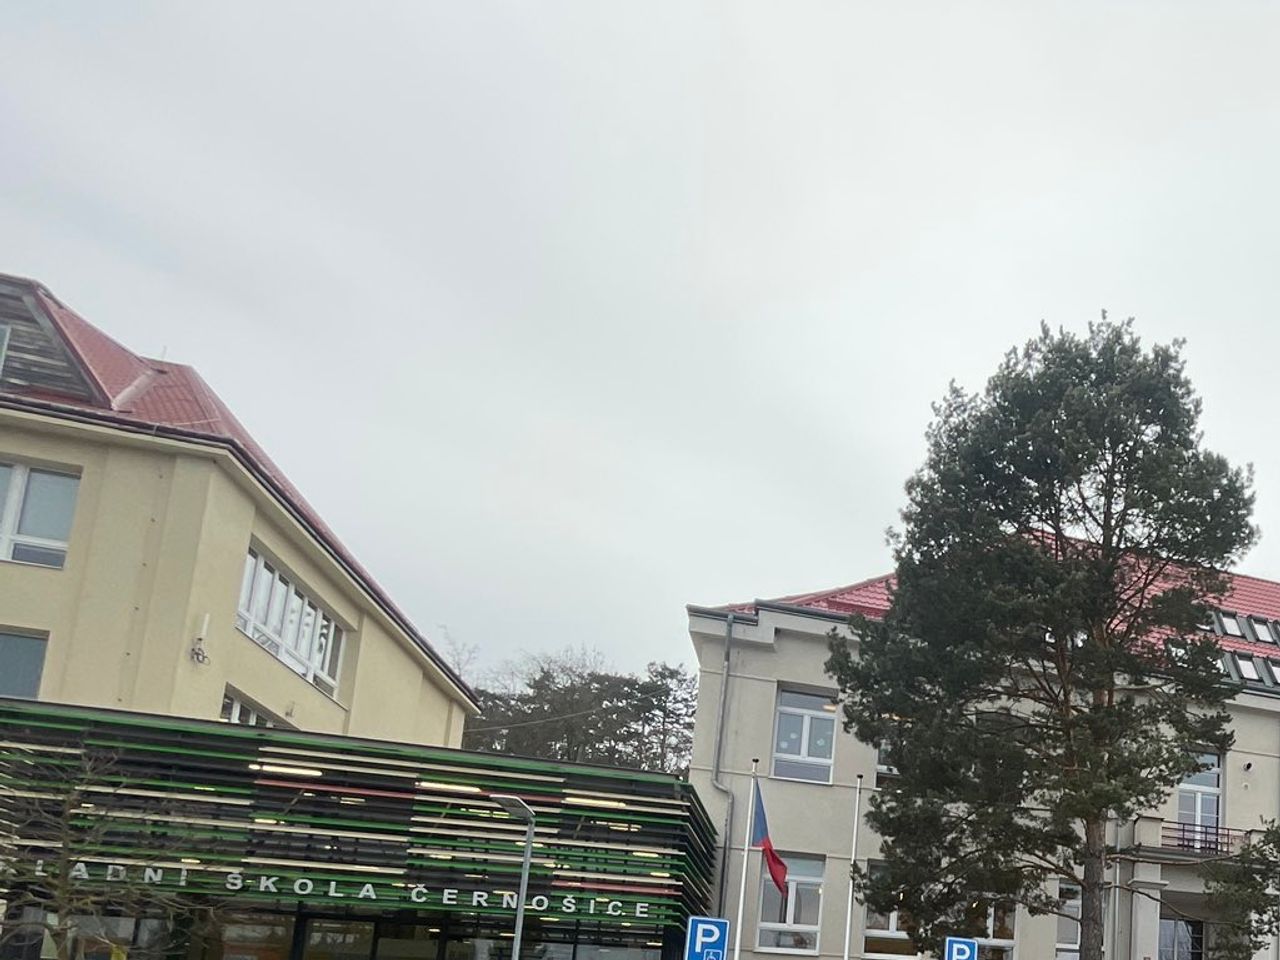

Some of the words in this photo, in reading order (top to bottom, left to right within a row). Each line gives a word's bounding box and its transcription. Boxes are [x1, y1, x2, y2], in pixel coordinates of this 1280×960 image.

[225, 869, 377, 899] ŠKOLA
[411, 883, 649, 918] ČERNOŠICE
[695, 924, 720, 952] P
